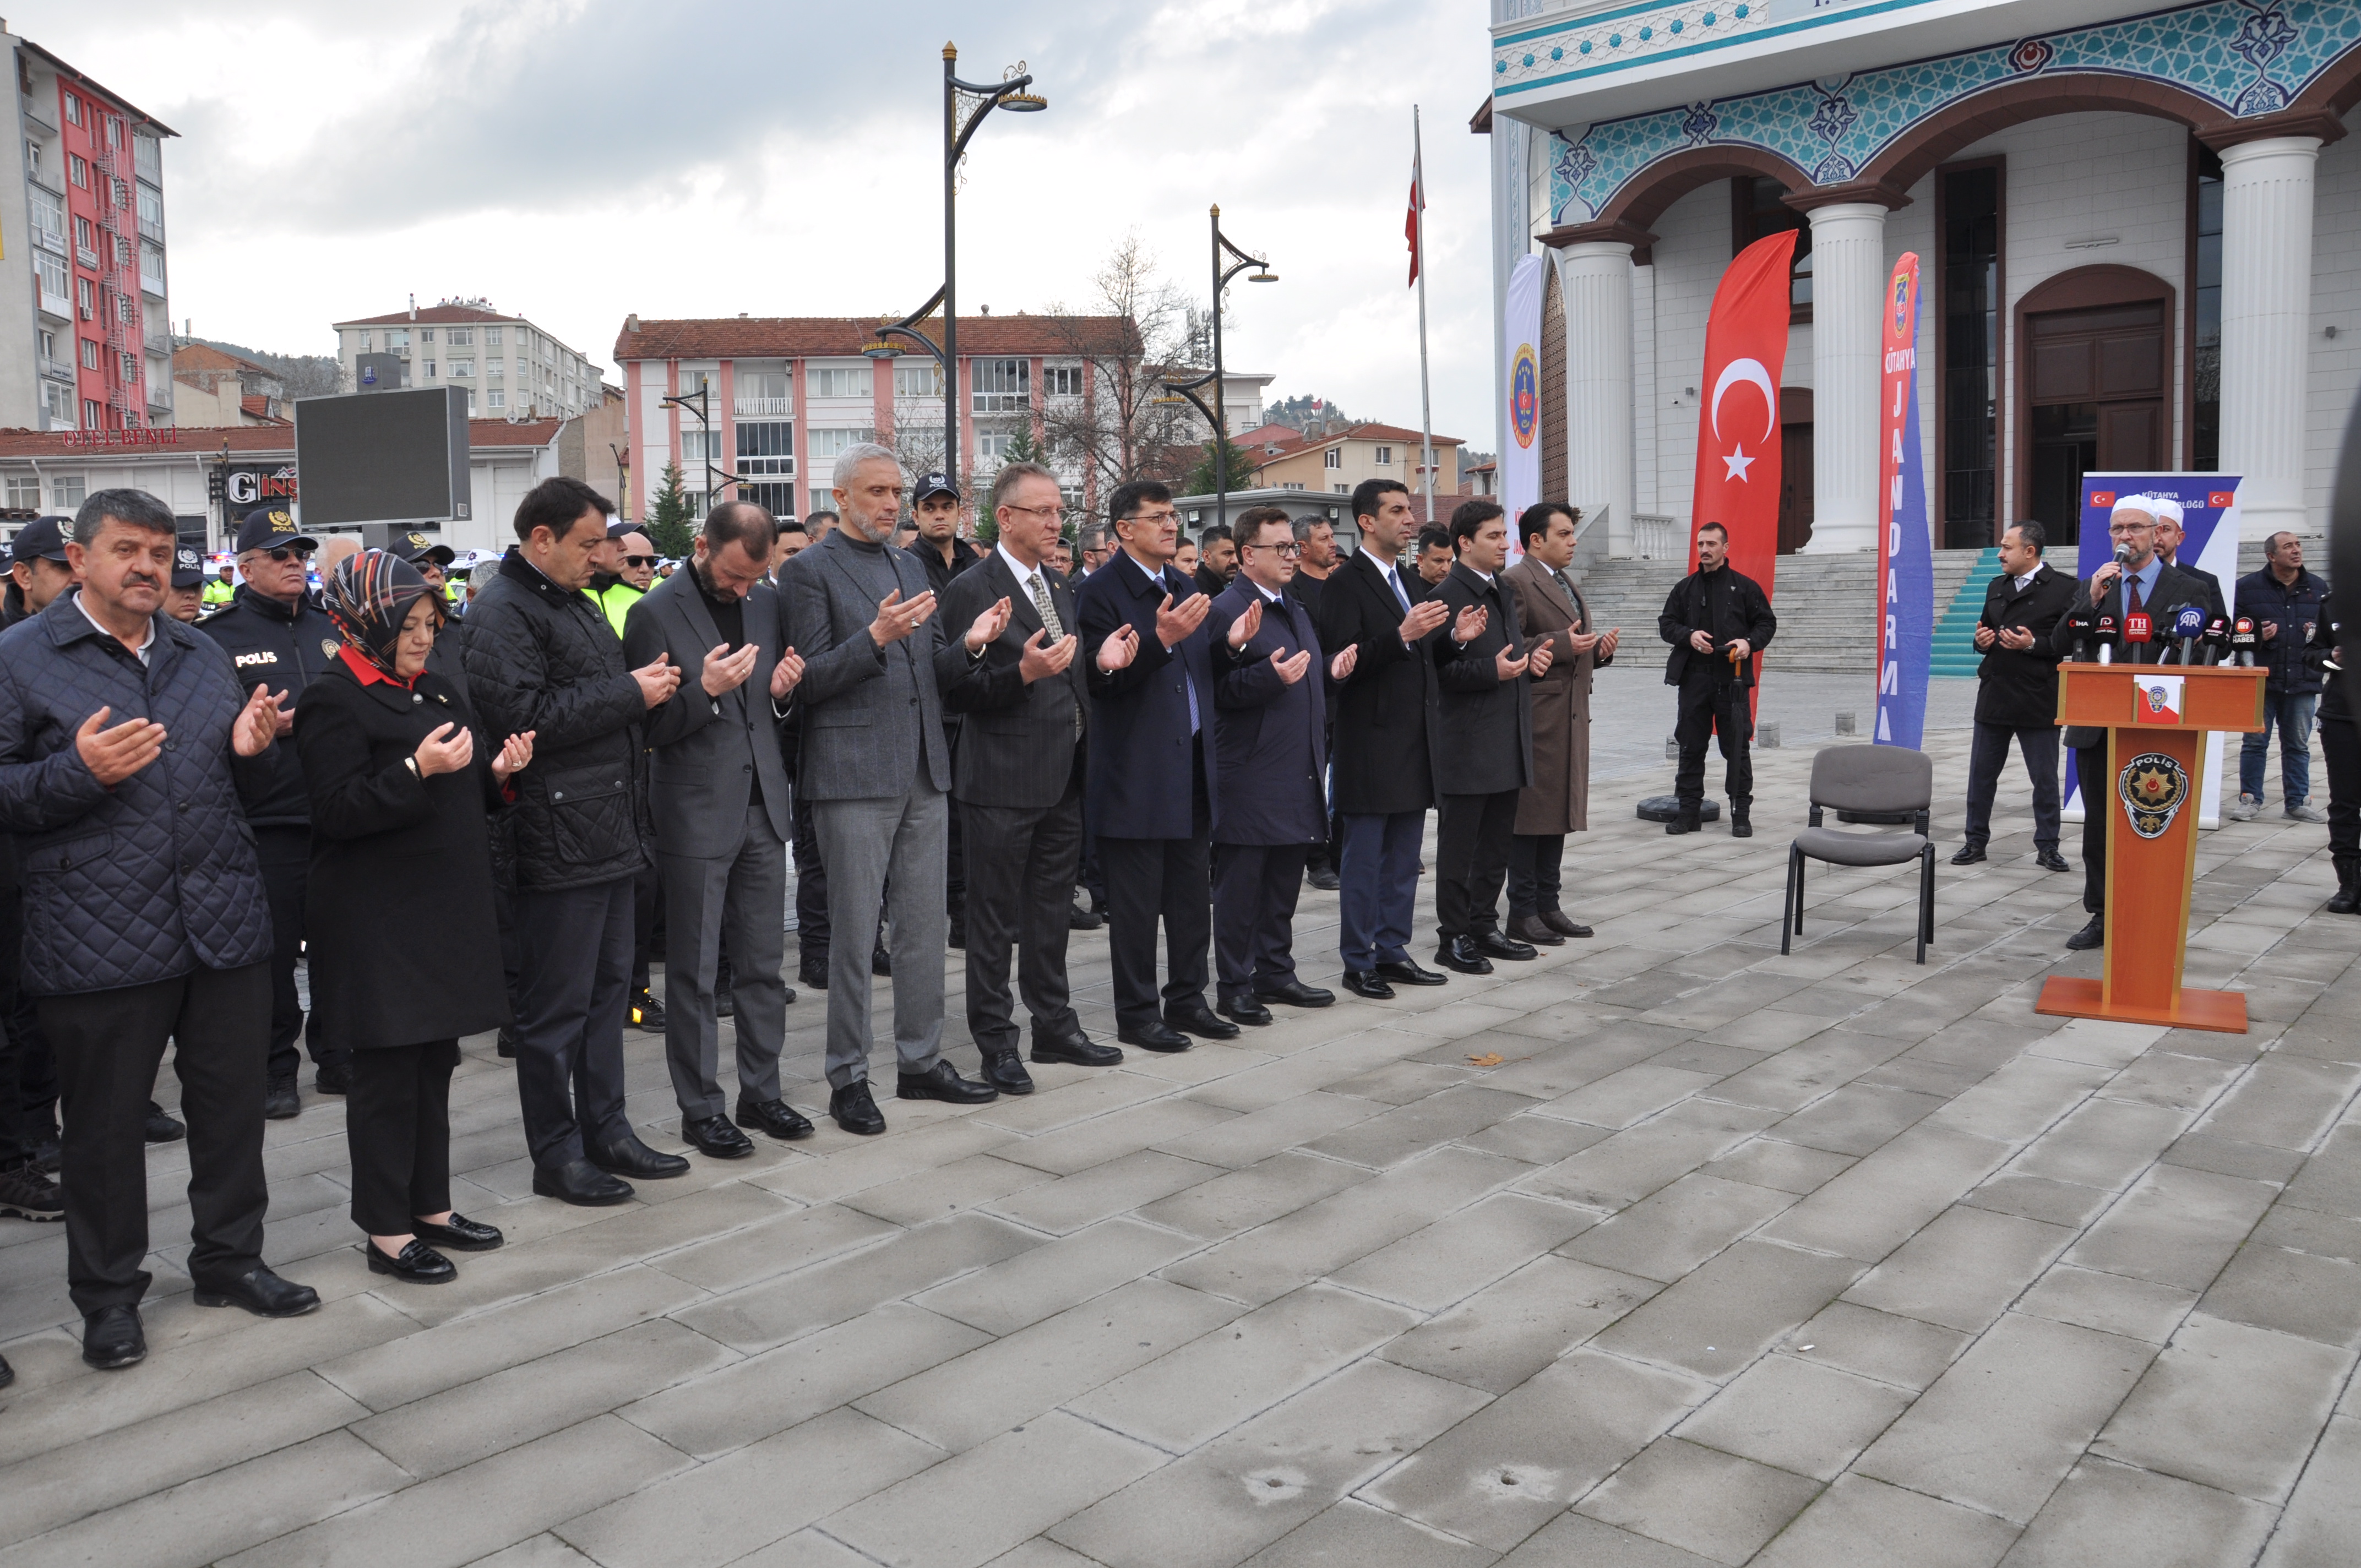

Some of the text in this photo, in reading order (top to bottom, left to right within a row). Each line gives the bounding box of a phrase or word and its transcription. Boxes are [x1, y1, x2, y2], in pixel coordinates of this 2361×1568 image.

[64, 429, 116, 447] OTEL
[2142, 491, 2179, 499] KÜTAHYA
[2128, 618, 2147, 629] TH
[2179, 614, 2199, 628] AA
